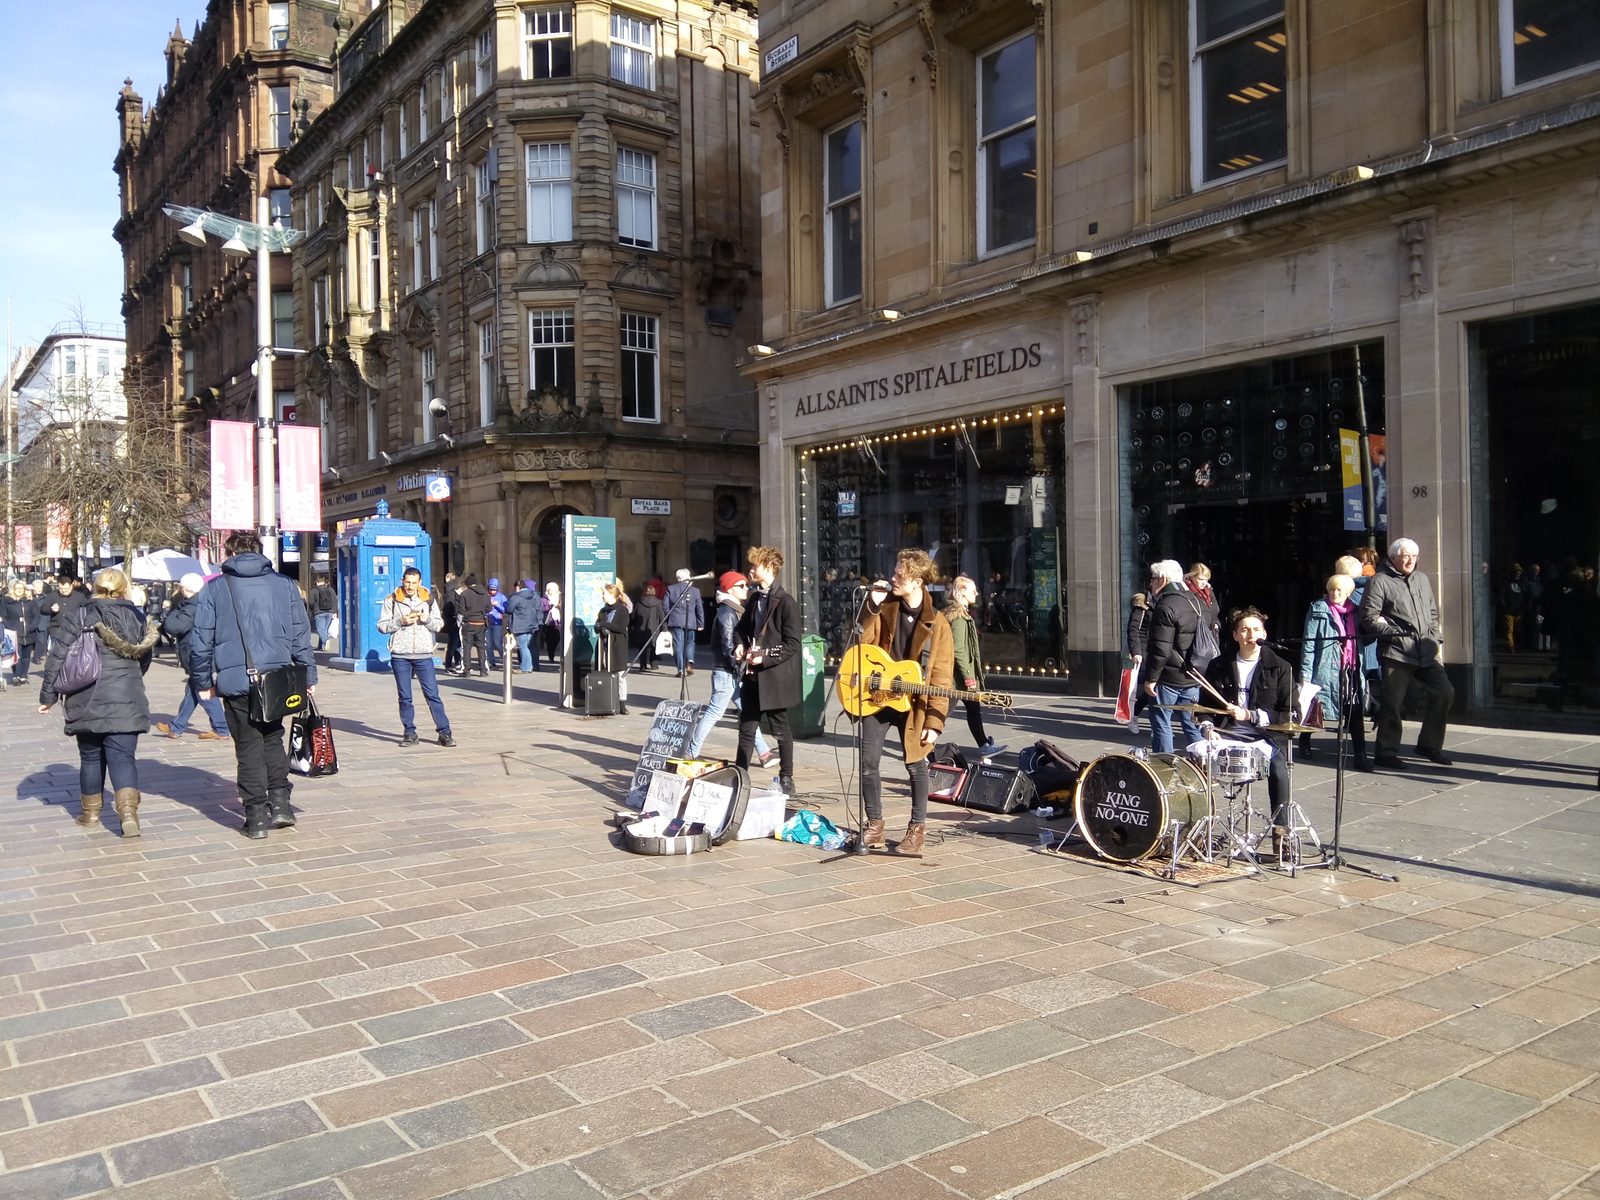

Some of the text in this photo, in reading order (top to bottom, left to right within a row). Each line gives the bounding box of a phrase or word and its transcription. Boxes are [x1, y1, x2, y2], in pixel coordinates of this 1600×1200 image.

[766, 38, 796, 62] BUCHANAN
[770, 49, 792, 67] STREET
[795, 342, 1042, 417] ALLSAINTS SPITALFIELDS
[1412, 485, 1428, 498] 98
[659, 718, 688, 736] GLASGOW
[1105, 791, 1141, 808] KING
[1095, 806, 1150, 827] NO-ONE
